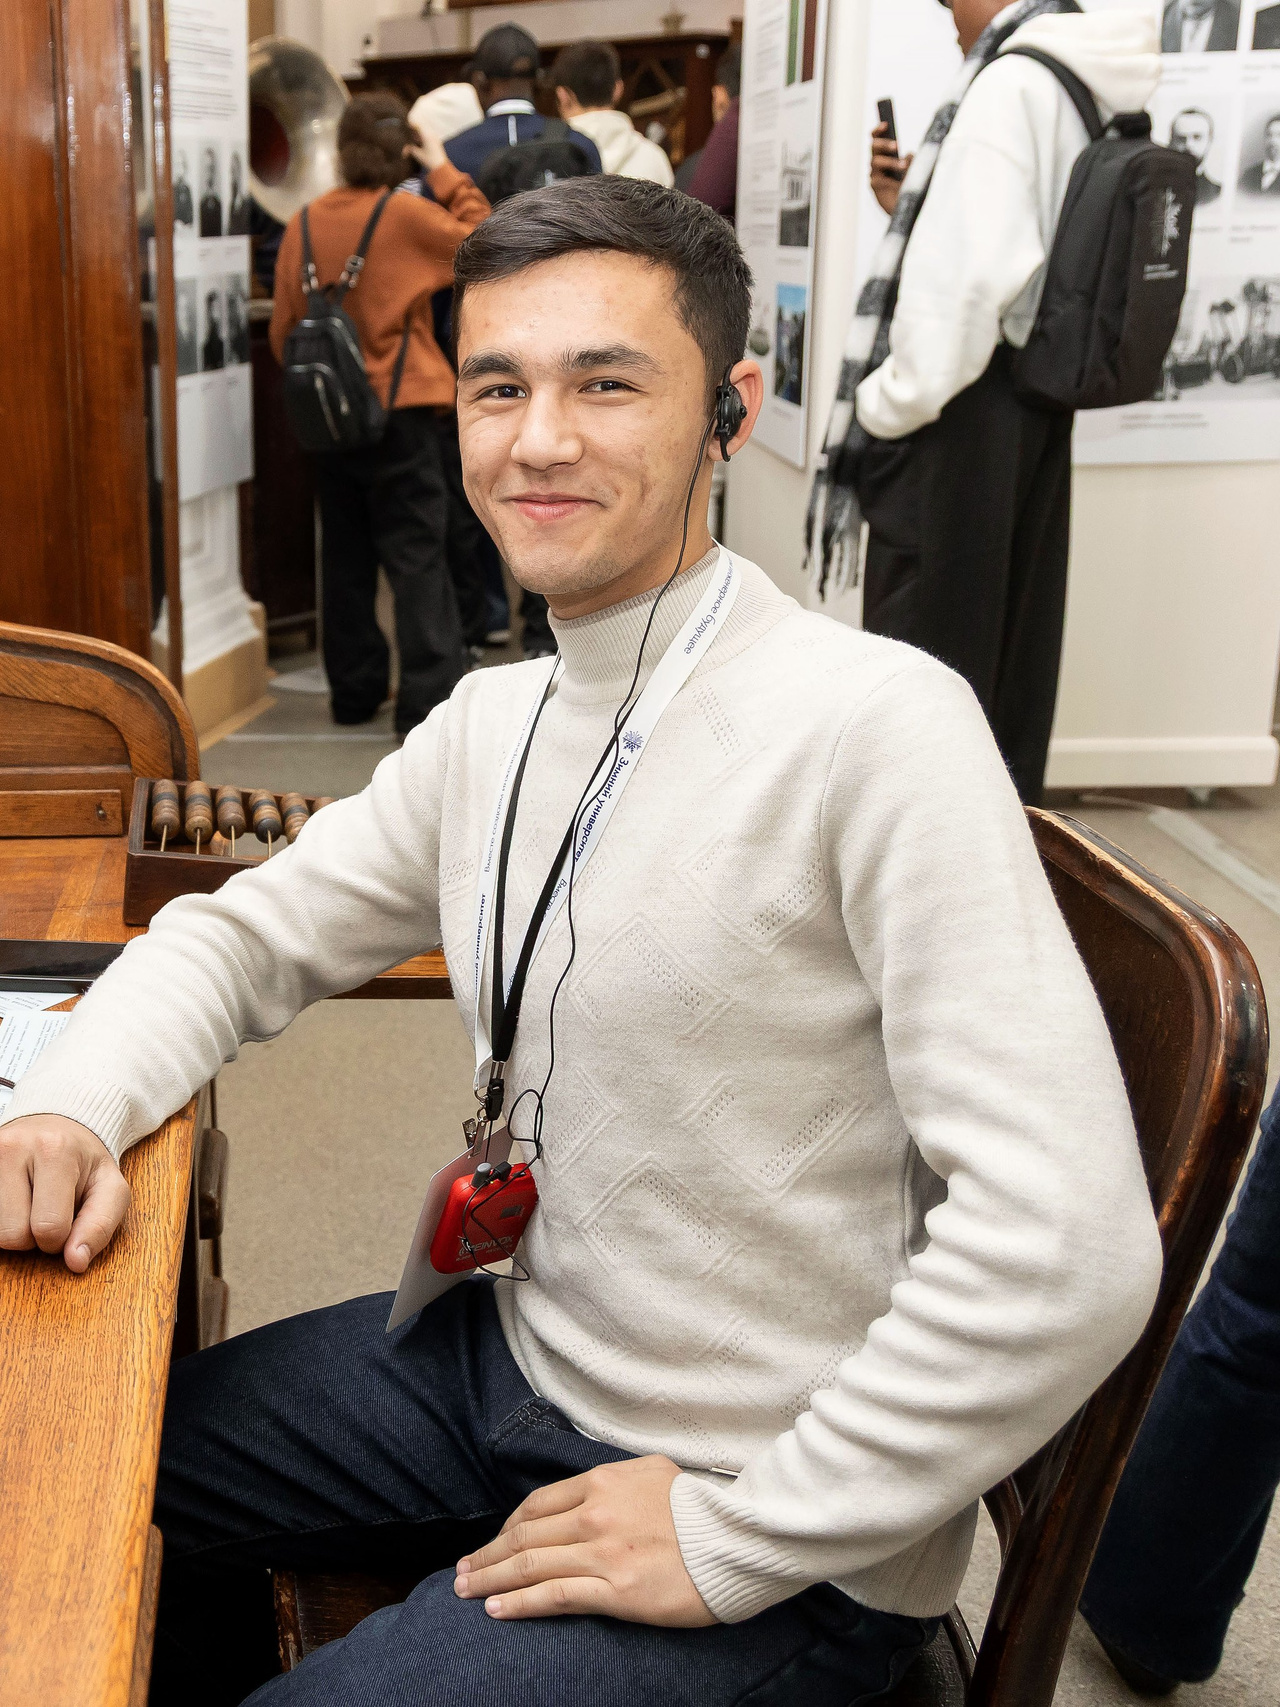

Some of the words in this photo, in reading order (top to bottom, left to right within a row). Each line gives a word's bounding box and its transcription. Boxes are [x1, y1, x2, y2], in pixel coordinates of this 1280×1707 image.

[683, 614, 716, 655] будущее
[602, 757, 629, 799] Зимний
[573, 797, 606, 863] университет
[476, 893, 486, 960] университет
